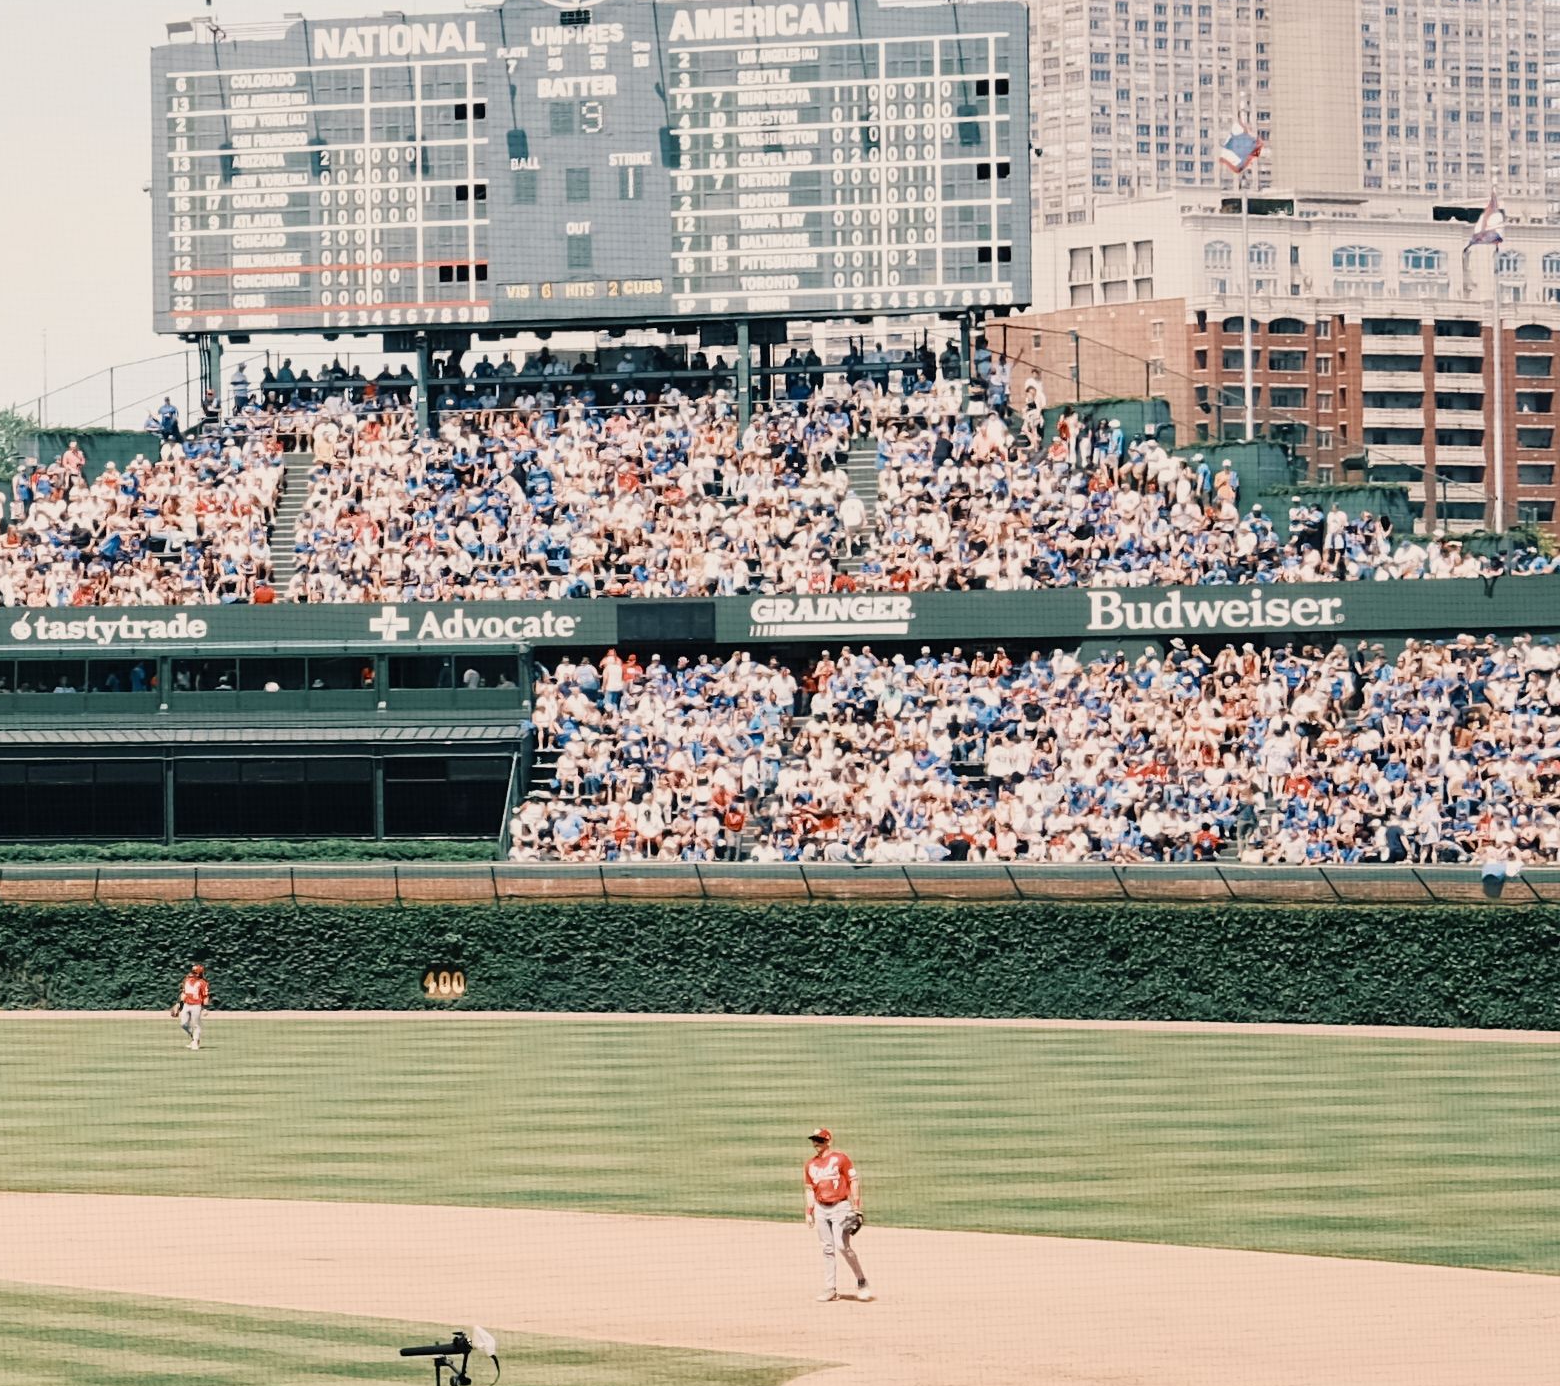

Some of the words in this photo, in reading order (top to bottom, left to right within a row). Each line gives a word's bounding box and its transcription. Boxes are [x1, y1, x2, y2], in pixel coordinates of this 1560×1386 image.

[668, 1, 849, 41] AMERICAN
[314, 21, 486, 59] NATIONAL
[531, 23, 624, 46] UMPIRES
[537, 75, 617, 98] BATTER
[581, 101, 603, 133] 9
[609, 152, 652, 166] STRIKE
[566, 221, 591, 235] OUT
[565, 282, 595, 297] HITS
[622, 279, 663, 295] CUBS
[232, 294, 266, 308] CUBS
[750, 596, 913, 623] GRAINGER
[1087, 589, 1342, 630] Budweiser
[35, 613, 207, 644] tastytrade
[417, 609, 576, 639] Advocate
[423, 971, 466, 994] 400
